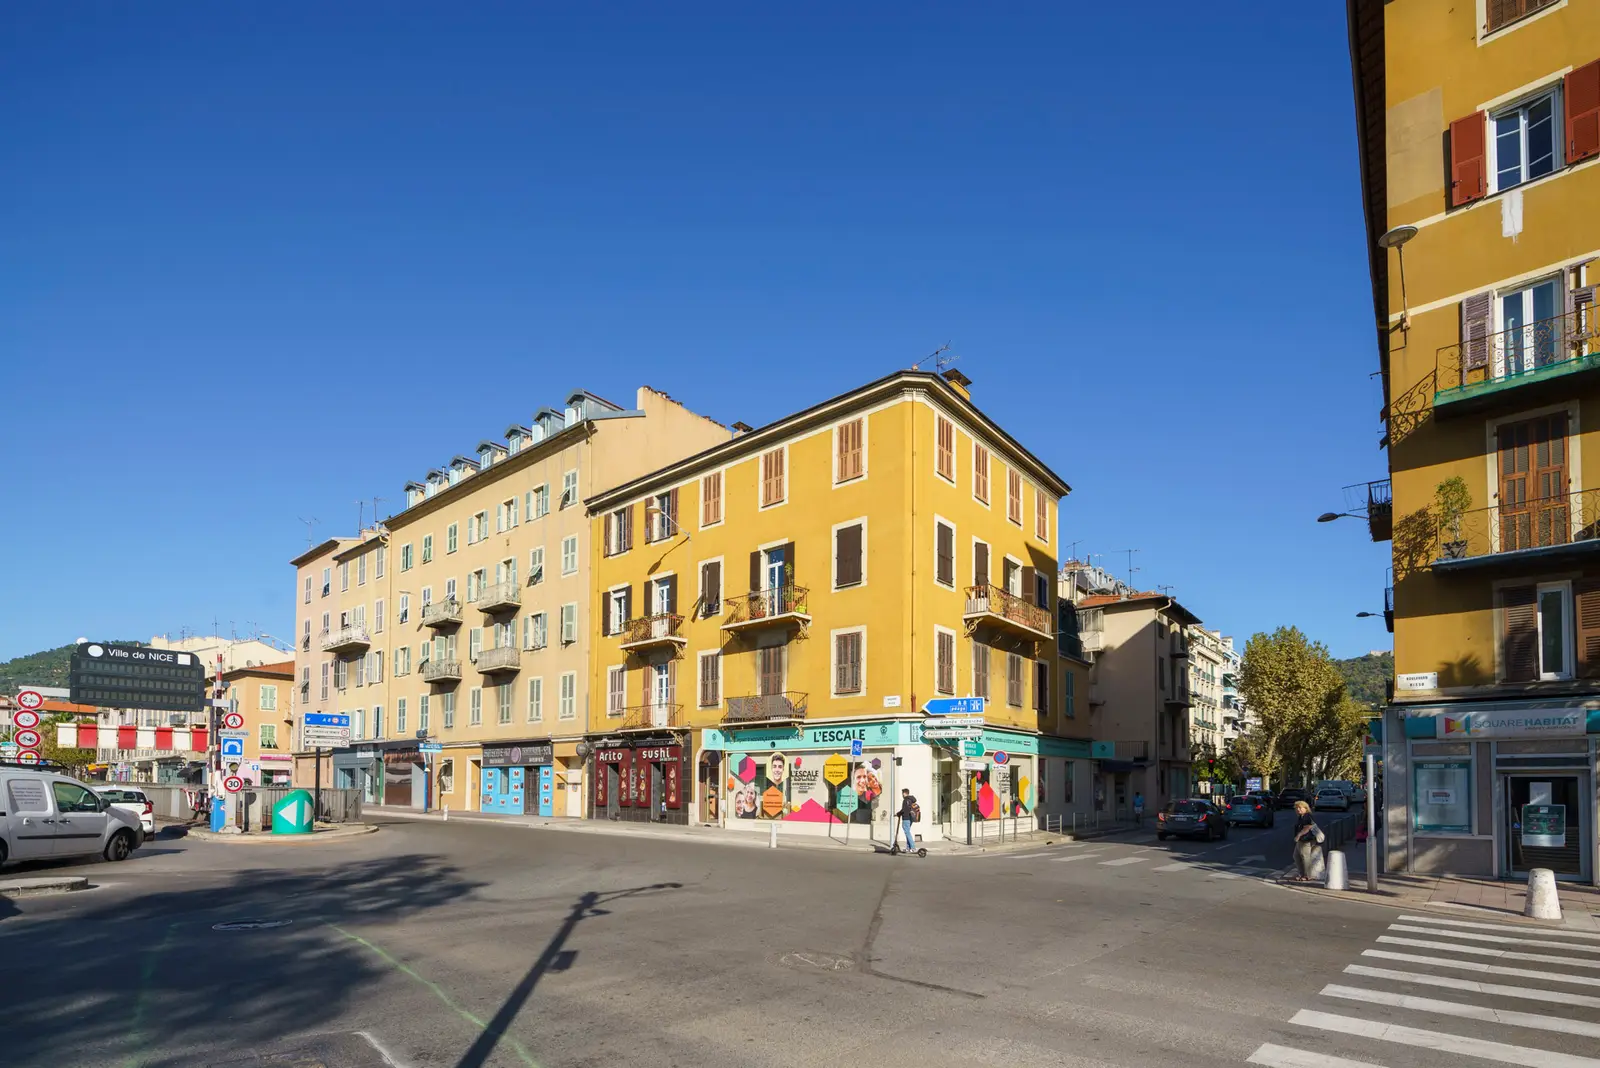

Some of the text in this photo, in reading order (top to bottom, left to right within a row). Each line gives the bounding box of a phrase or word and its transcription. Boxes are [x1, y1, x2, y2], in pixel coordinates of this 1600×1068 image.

[108, 648, 173, 662] Ville de NICE
[1474, 716, 1579, 729] SQUARE HABITAT
[813, 728, 866, 743] L'ESCALE
[599, 747, 670, 761] Arito sushi
[228, 780, 240, 788] 30
